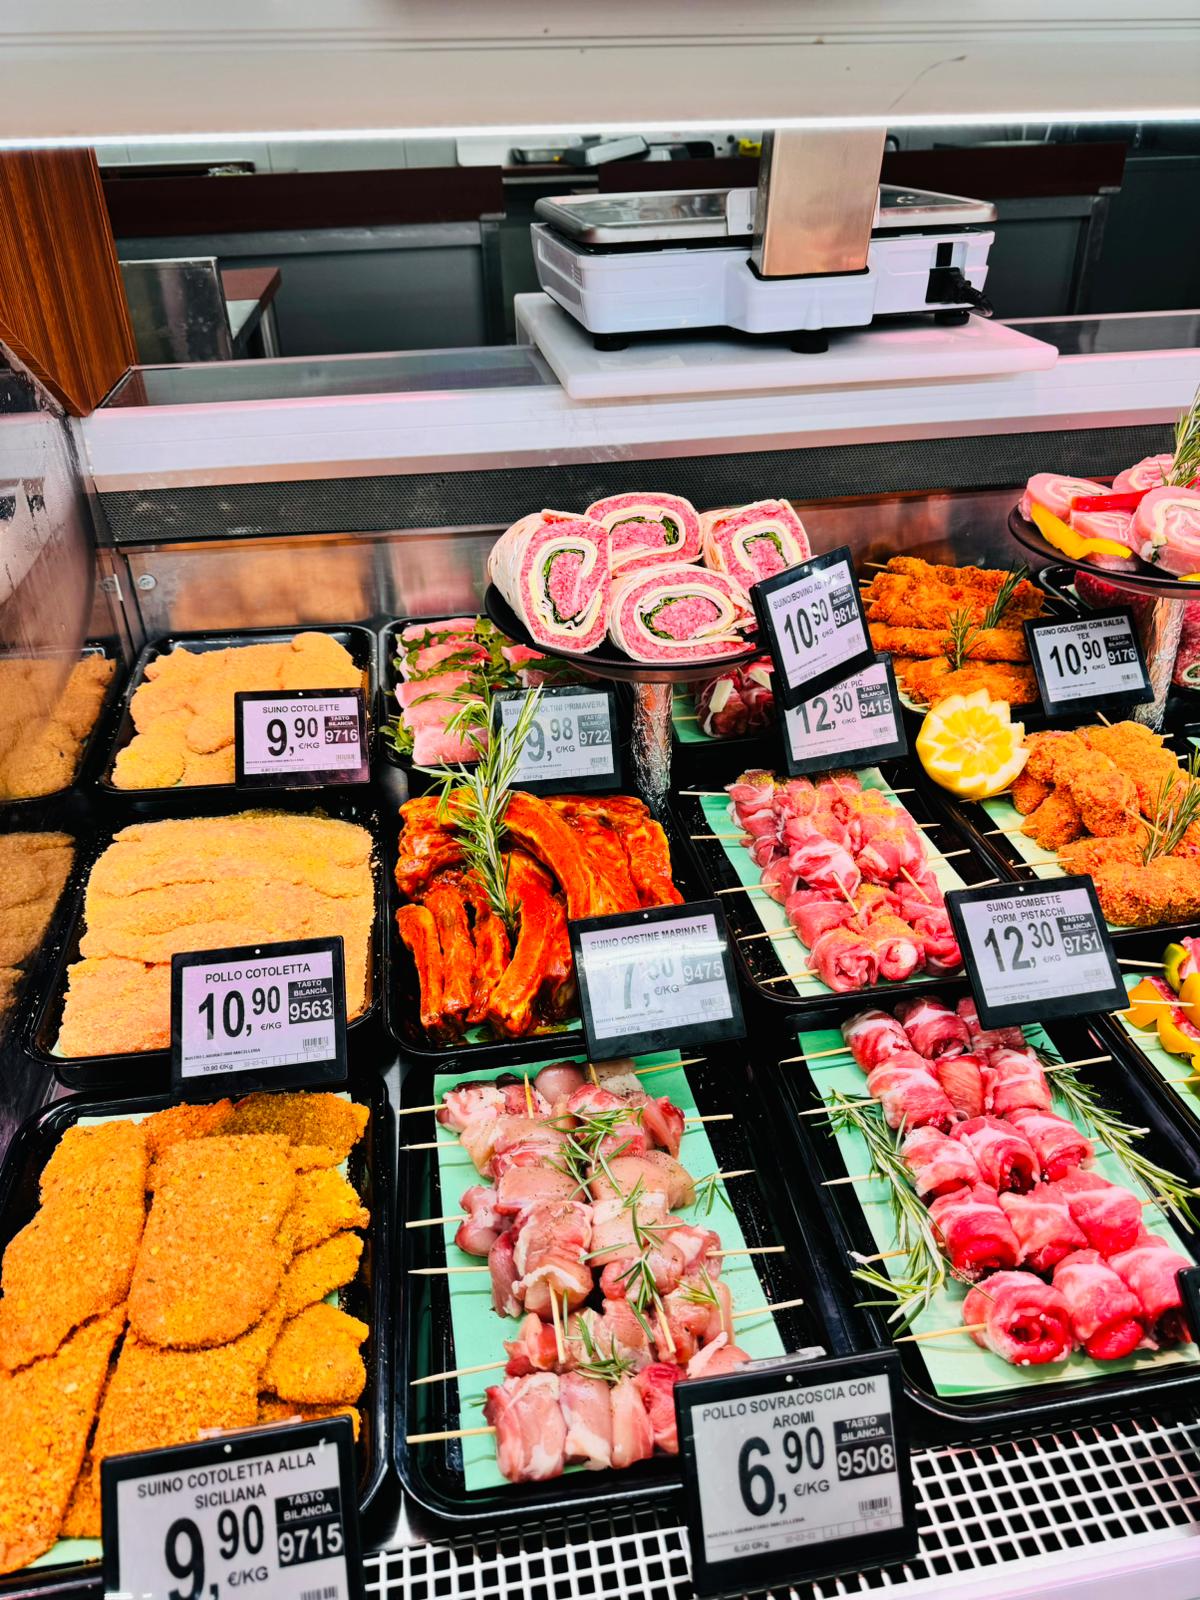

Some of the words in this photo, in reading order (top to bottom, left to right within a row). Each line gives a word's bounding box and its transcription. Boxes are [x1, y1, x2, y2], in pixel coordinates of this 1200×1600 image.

[833, 601, 858, 625] 9814
[1036, 628, 1056, 637] SUINO
[1057, 623, 1087, 634] GOLOSINI
[1088, 621, 1103, 630] CON
[1103, 618, 1125, 627] SALSA
[1077, 632, 1090, 640] TEX
[1108, 648, 1136, 664] 9176
[860, 690, 885, 699] BILANCIA
[863, 684, 881, 692] TASTO
[262, 706, 289, 714] SUINO
[290, 704, 340, 713] COTOLETTE
[564, 700, 607, 710] PRIMAVERA
[860, 699, 891, 717] 9415
[325, 729, 359, 743] 9716
[580, 730, 610, 745] 9722
[298, 742, 320, 750] €/KG
[986, 899, 1014, 913] SUINO
[1015, 895, 1062, 909] BOMBETTE
[1062, 922, 1092, 932] BILANCIA
[1063, 915, 1085, 923] TASTO
[590, 938, 619, 951] SUINO
[621, 932, 660, 945] COSTINE
[661, 924, 709, 940] MARINATE
[1063, 932, 1101, 954] 9751
[1043, 954, 1061, 963] €/KG
[205, 970, 242, 984] POLLO
[245, 962, 311, 979] COTOLETTA
[683, 961, 723, 982] 9475
[293, 986, 328, 997] BILANCIA
[297, 979, 322, 988] TASTO
[654, 984, 680, 996] €/KG
[289, 999, 333, 1021] 9563
[260, 1022, 282, 1031] €/KG
[702, 1402, 747, 1422] POLLO
[749, 1389, 846, 1414] SOVRACOSCIA
[848, 1381, 876, 1397] CON
[772, 1410, 815, 1430] AROMI
[844, 1415, 878, 1430] TASTO
[841, 1426, 886, 1443] BILANCIA
[837, 1443, 895, 1477] 9508
[137, 1477, 183, 1499] SUINO
[187, 1459, 274, 1489] COTOLETTA
[278, 1452, 316, 1471] ALLA
[195, 1483, 267, 1510] SICILIANA
[793, 1479, 830, 1497] €/KG
[288, 1491, 325, 1507] TASTO
[283, 1503, 333, 1522] BILANCIA
[278, 1522, 343, 1563] 9715
[227, 1566, 269, 1588] €/KG
